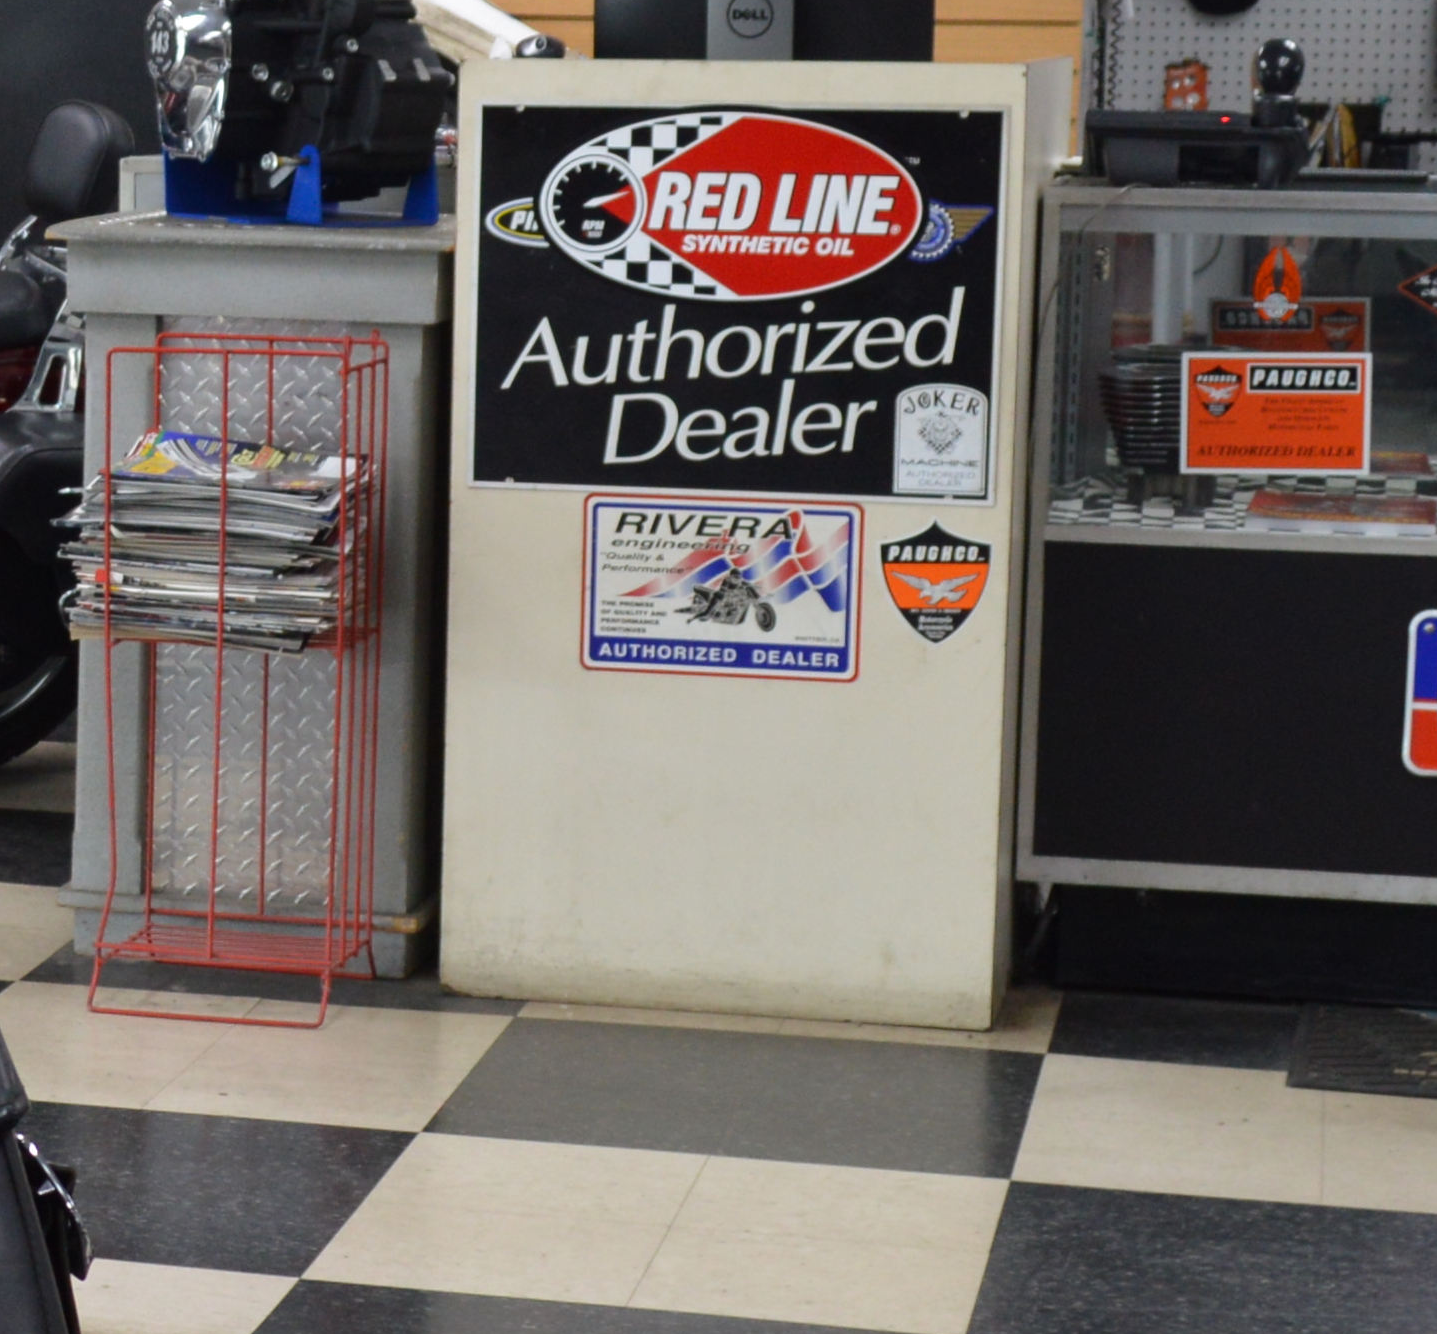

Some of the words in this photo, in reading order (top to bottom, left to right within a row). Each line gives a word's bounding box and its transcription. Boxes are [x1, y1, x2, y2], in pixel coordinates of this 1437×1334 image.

[732, 8, 769, 21] DELL
[647, 170, 762, 232] RED
[768, 173, 901, 235] LINE
[581, 219, 606, 232] RPM
[681, 233, 810, 255] SYNTHETIC
[815, 236, 855, 257] OIL
[500, 286, 966, 389] Authorized
[1251, 368, 1351, 388] PAUGHCO
[903, 390, 981, 416] JOKER
[602, 379, 877, 465] Dealer
[1197, 445, 1293, 457] AUTHORIZED
[1296, 445, 1357, 457] DEALER
[901, 458, 980, 468] MACHINE
[614, 511, 795, 540] RIVERA
[611, 537, 752, 555] engineering
[887, 545, 980, 562] PAUGHCO
[656, 553, 665, 562] &
[598, 641, 738, 663] AUTHORIZED
[752, 649, 840, 668] DEALER
